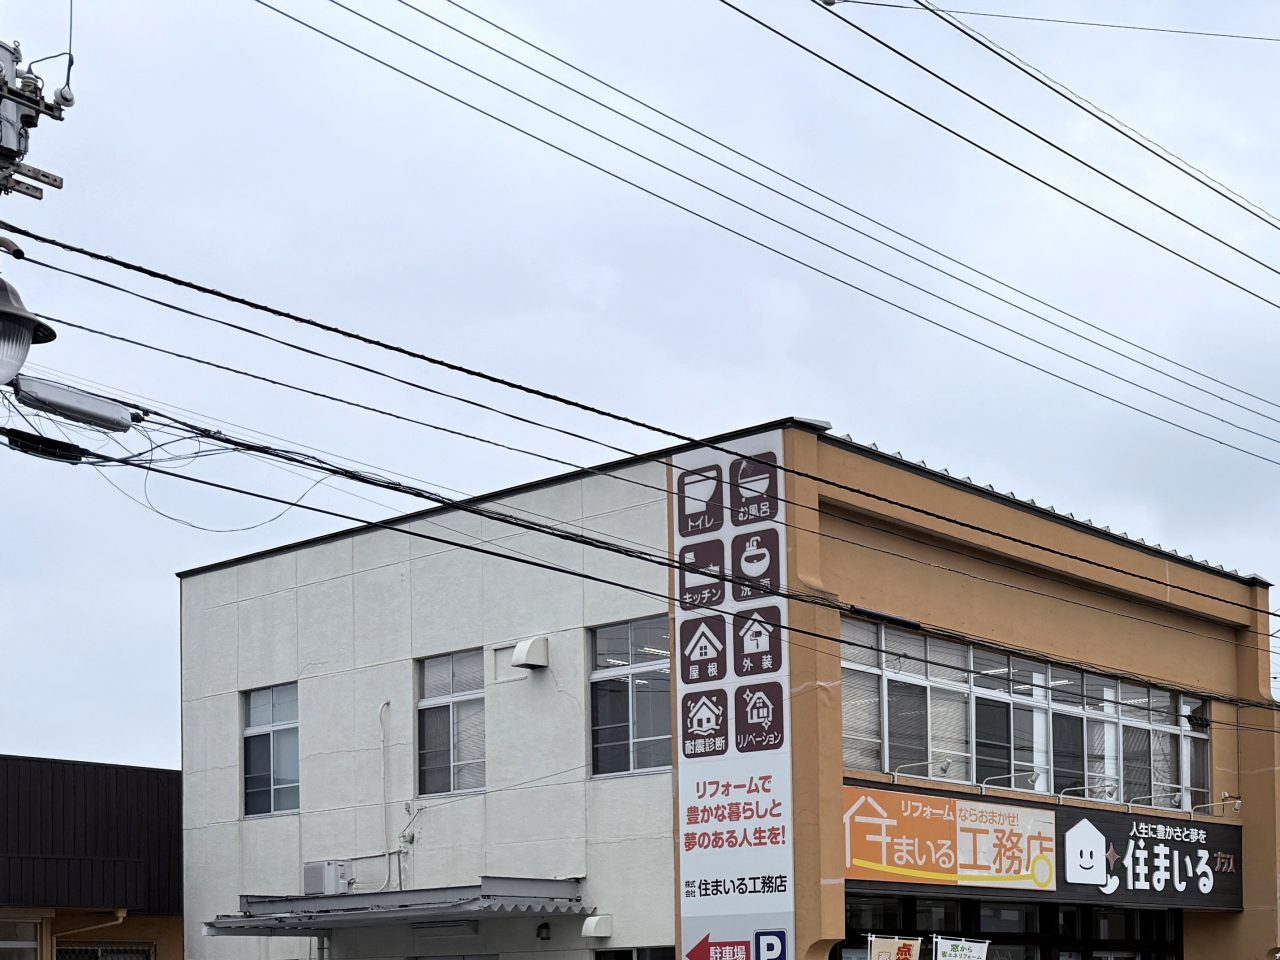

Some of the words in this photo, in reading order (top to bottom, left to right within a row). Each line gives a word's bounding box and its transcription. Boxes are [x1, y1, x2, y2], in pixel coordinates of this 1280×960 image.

[738, 501, 771, 522] お風呂
[687, 516, 714, 532] トイレ
[683, 588, 721, 607] キッチン
[689, 662, 719, 679] 屋根
[742, 654, 773, 671] 外装
[684, 738, 726, 756] 耐震診断
[737, 732, 782, 748] リノベーション
[696, 774, 773, 799] リフォームで
[686, 799, 782, 825] 豊かな暮らしと
[683, 825, 787, 851] 夢のある人生を!
[1129, 821, 1207, 844] 人生に豊かさと夢を
[698, 874, 788, 897] 住まいる工務店
[941, 951, 982, 960] 省エネリフォーム
[950, 944, 974, 953] 窓から
